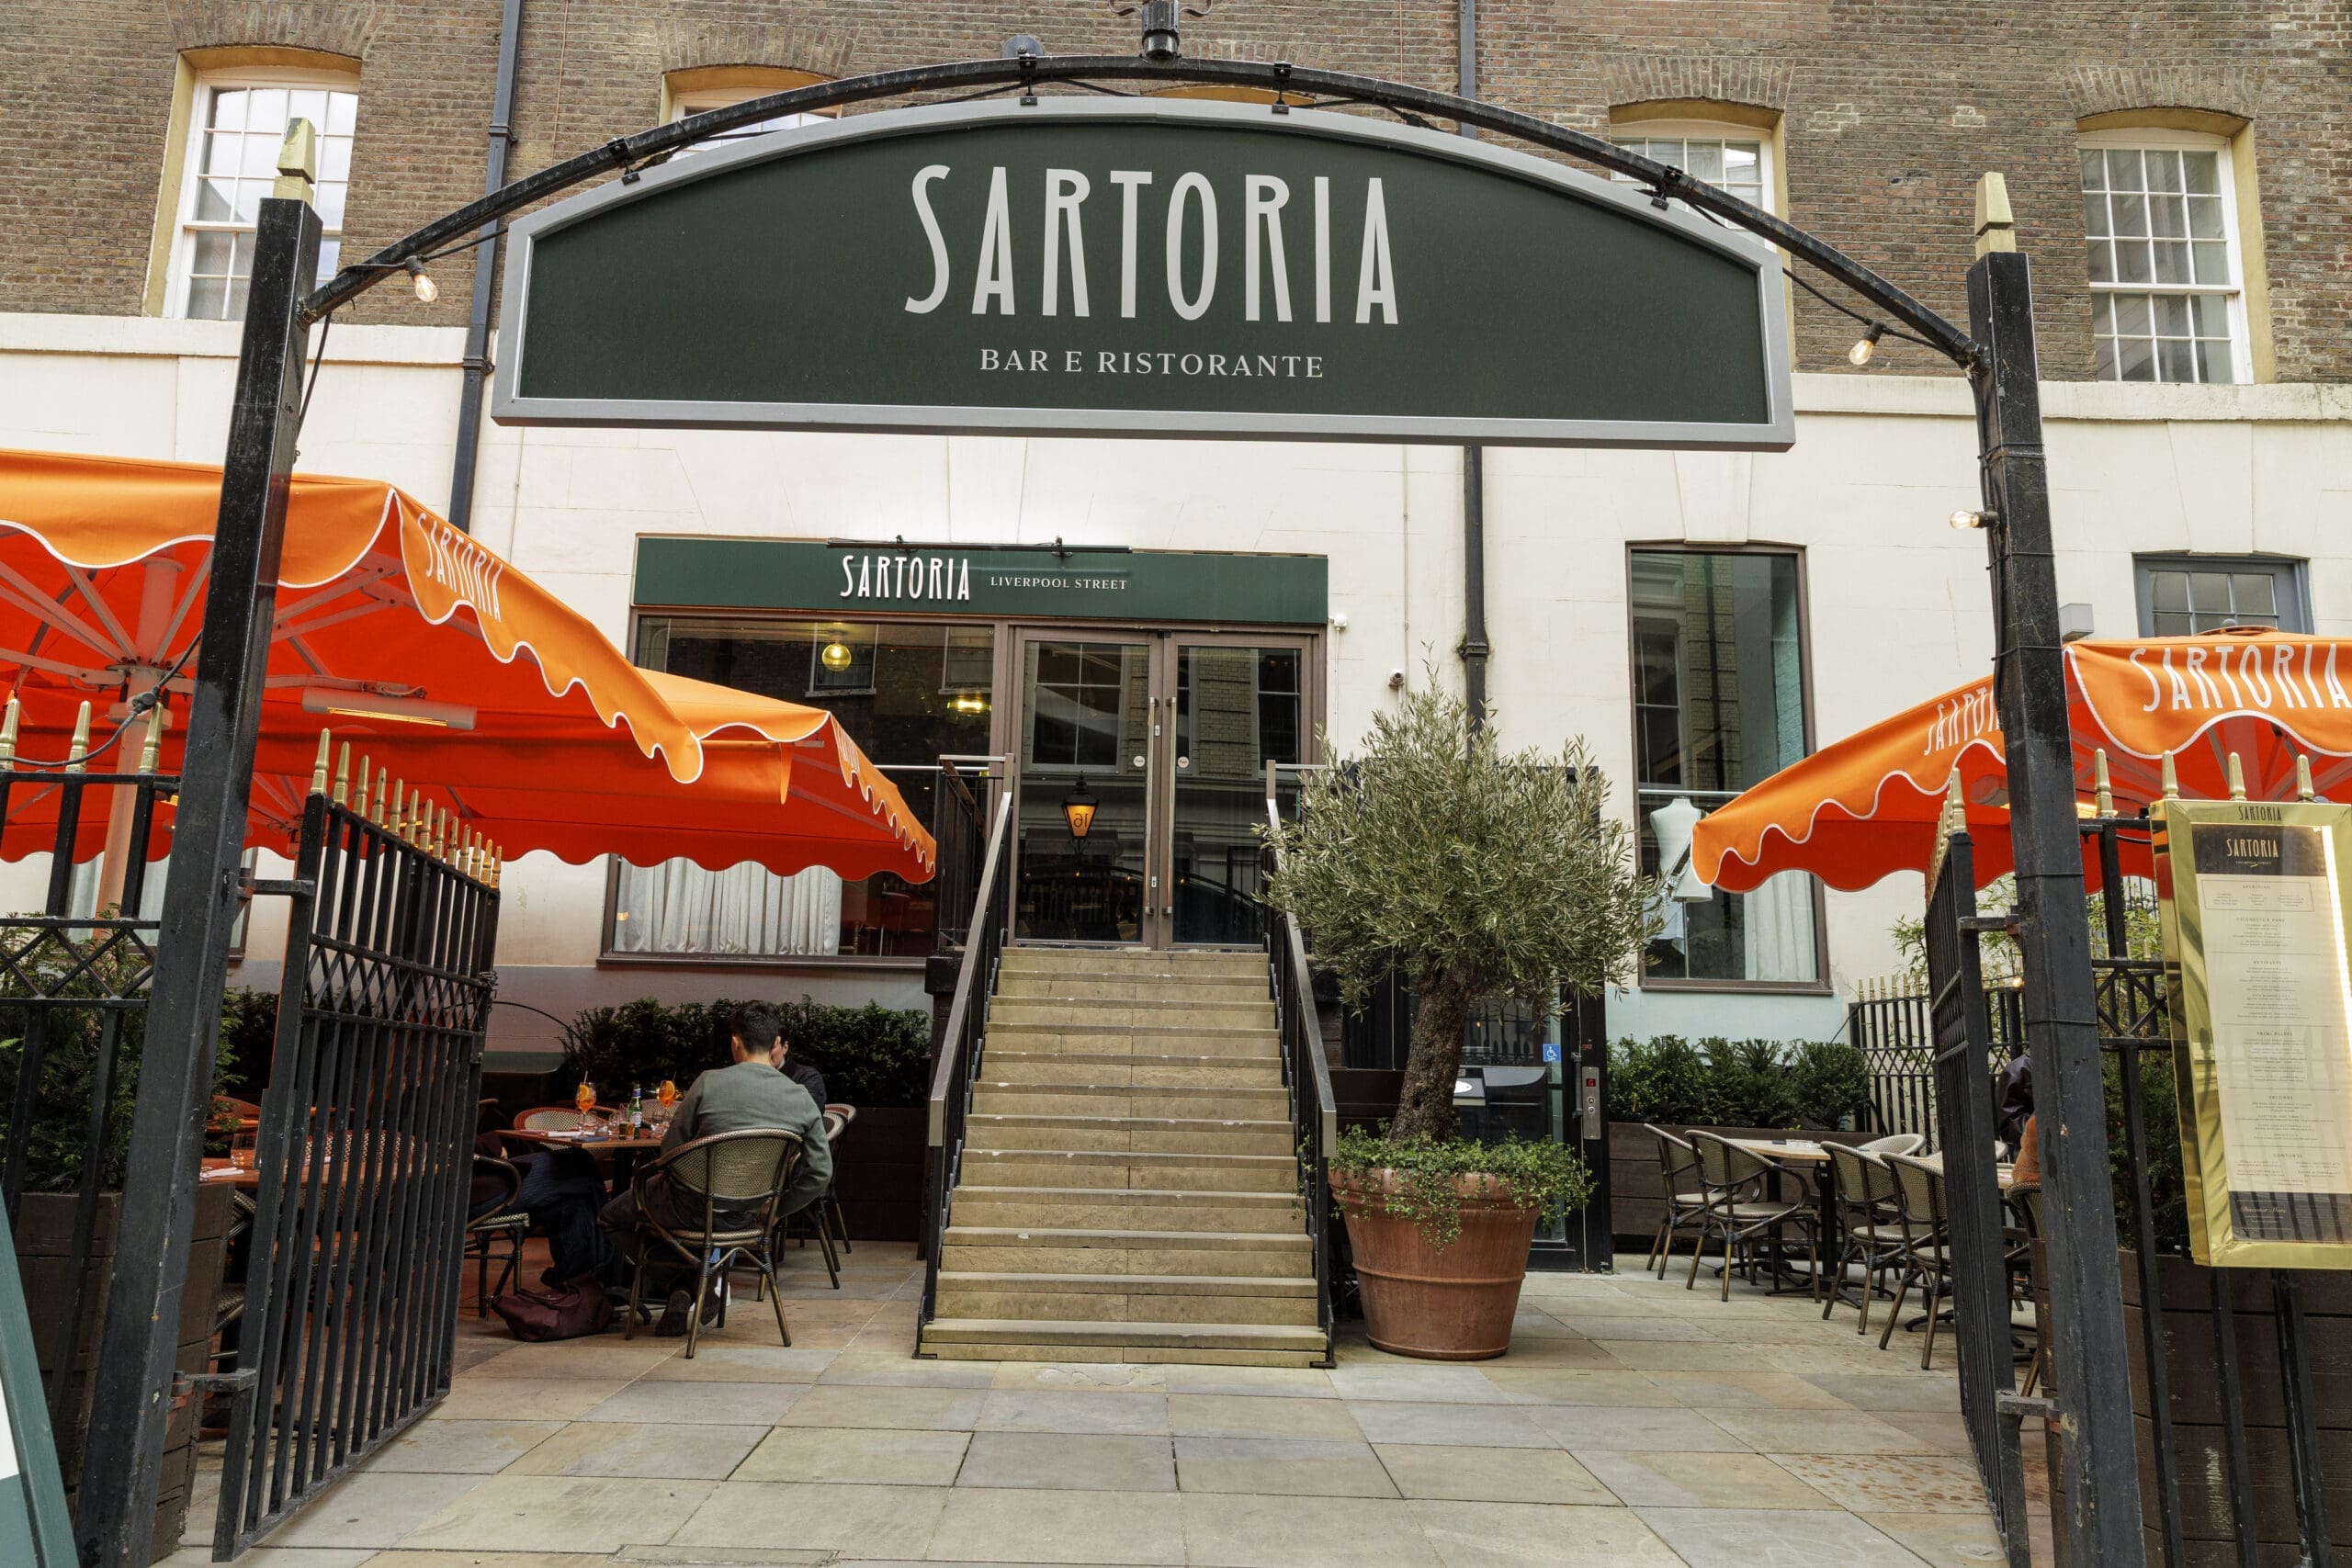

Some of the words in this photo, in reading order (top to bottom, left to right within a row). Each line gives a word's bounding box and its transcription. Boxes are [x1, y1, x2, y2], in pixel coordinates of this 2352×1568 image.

[904, 164, 1399, 325] SARTORIA
[979, 348, 1049, 372] BAR
[1065, 350, 1083, 373] E
[1098, 351, 1324, 378] RISTORANTE
[417, 512, 503, 623] SARTORIA
[840, 555, 970, 601] SARTORIA
[990, 576, 1069, 589] LIVERPOOL
[1075, 579, 1127, 590] STREET
[2130, 643, 2352, 712] SARTORIA
[2238, 805, 2282, 821] SARTORIA
[2226, 838, 2279, 858] SARTORIA
